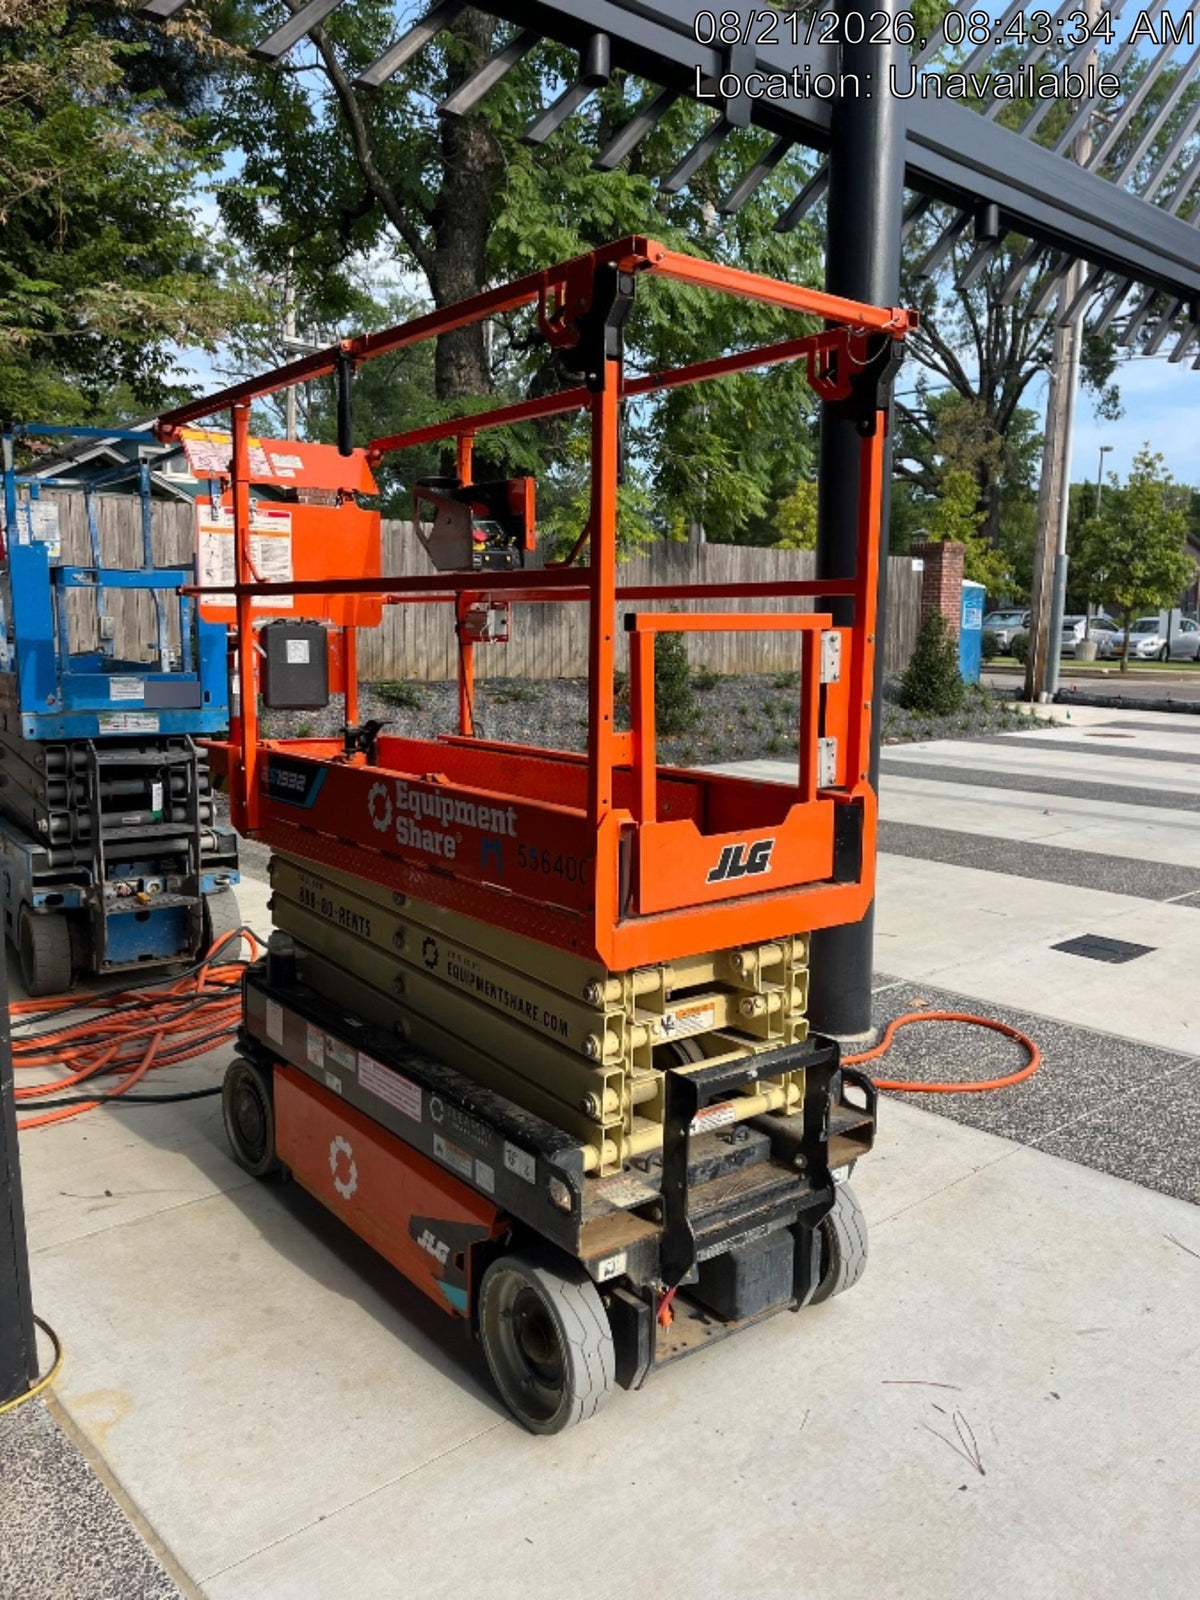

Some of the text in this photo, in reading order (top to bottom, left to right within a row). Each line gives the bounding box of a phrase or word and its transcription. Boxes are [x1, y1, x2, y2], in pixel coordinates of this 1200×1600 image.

[395, 780, 518, 838] Equipment
[395, 815, 457, 859] Share
[706, 838, 775, 884] JLG
[447, 962, 568, 1037] EQUIPMENTSHARE.COM
[417, 1229, 450, 1264] JLG
